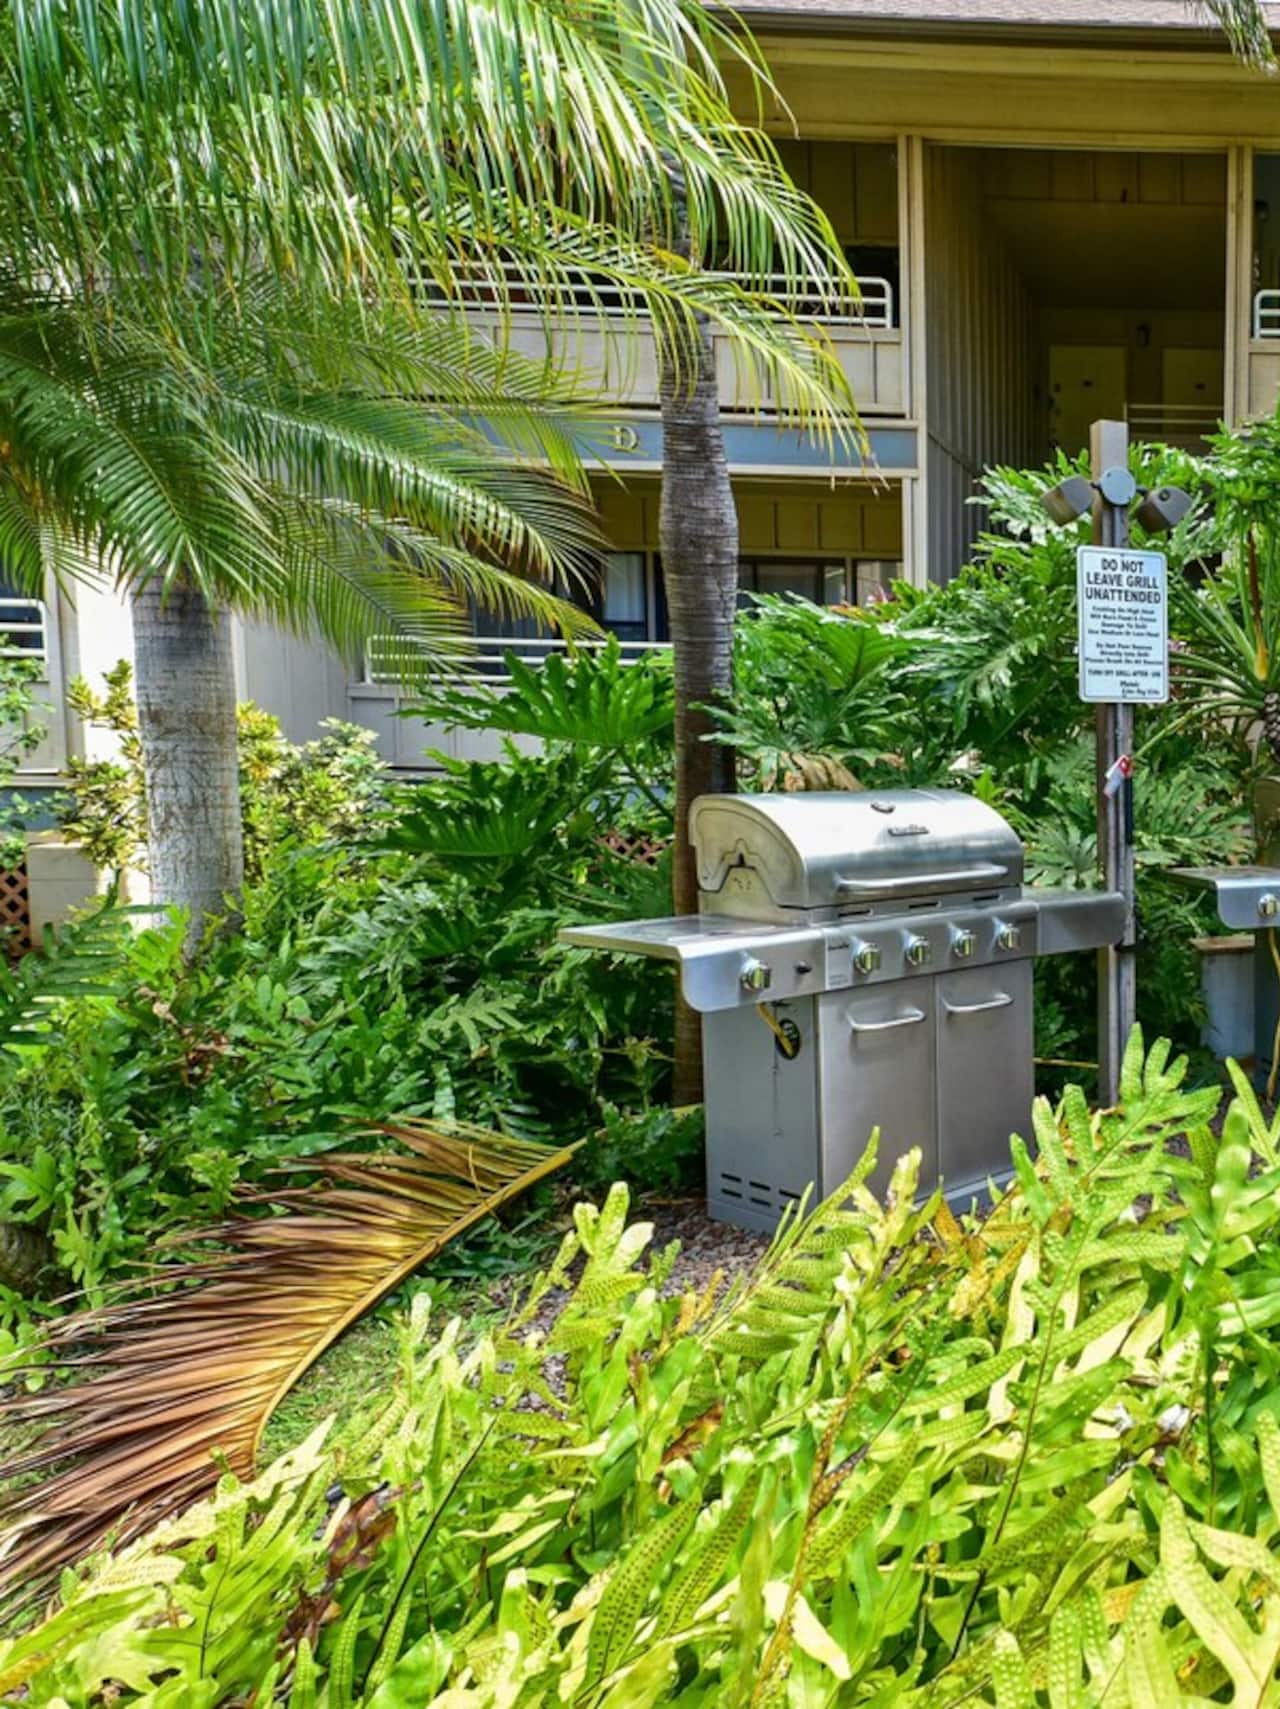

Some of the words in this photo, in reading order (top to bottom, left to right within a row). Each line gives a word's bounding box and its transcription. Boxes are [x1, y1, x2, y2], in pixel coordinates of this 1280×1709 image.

[1102, 558, 1118, 571] DO
[1121, 560, 1144, 573] NOT
[1086, 572, 1122, 587] LEAVE
[1126, 576, 1158, 588] GRILL
[1086, 587, 1160, 604] UNATTENDED
